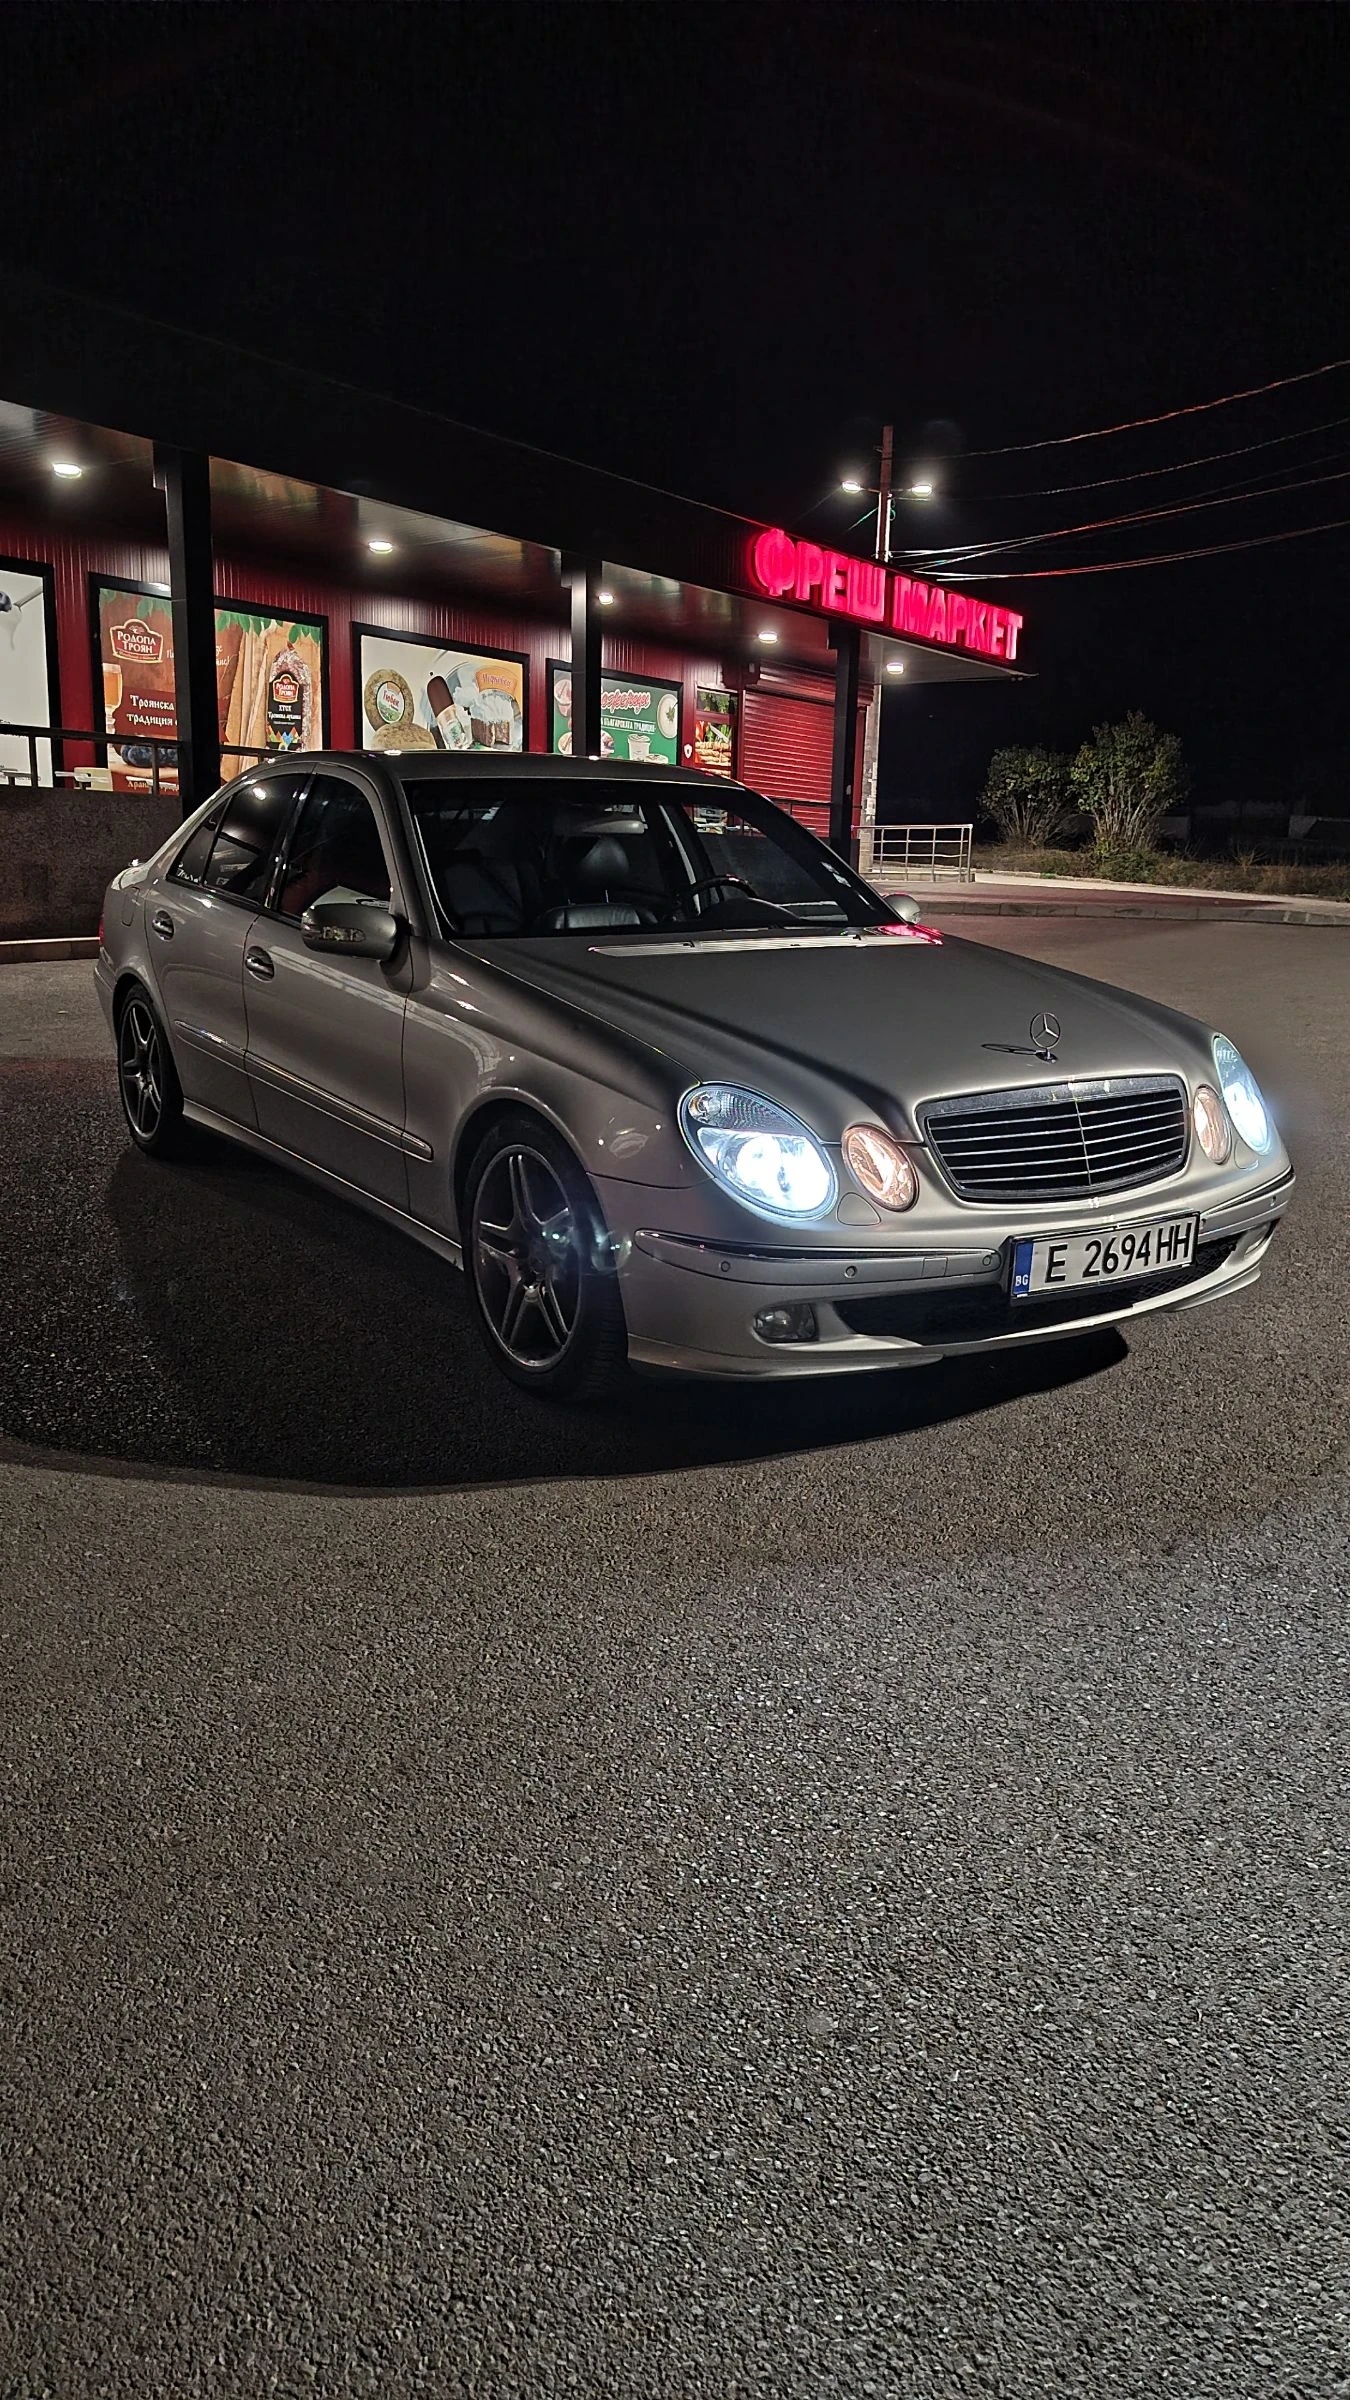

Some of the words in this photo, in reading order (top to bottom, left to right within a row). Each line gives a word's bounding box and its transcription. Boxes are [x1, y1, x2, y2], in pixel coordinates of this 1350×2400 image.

[893, 576, 1023, 659] МАРКЕТ
[117, 631, 156, 646] РОДОПА
[122, 640, 153, 654] ТРОЯН
[130, 694, 175, 711] Троянска
[126, 713, 173, 727] традиция
[1045, 1244, 1068, 1283] E
[1015, 1274, 1029, 1287] BG
